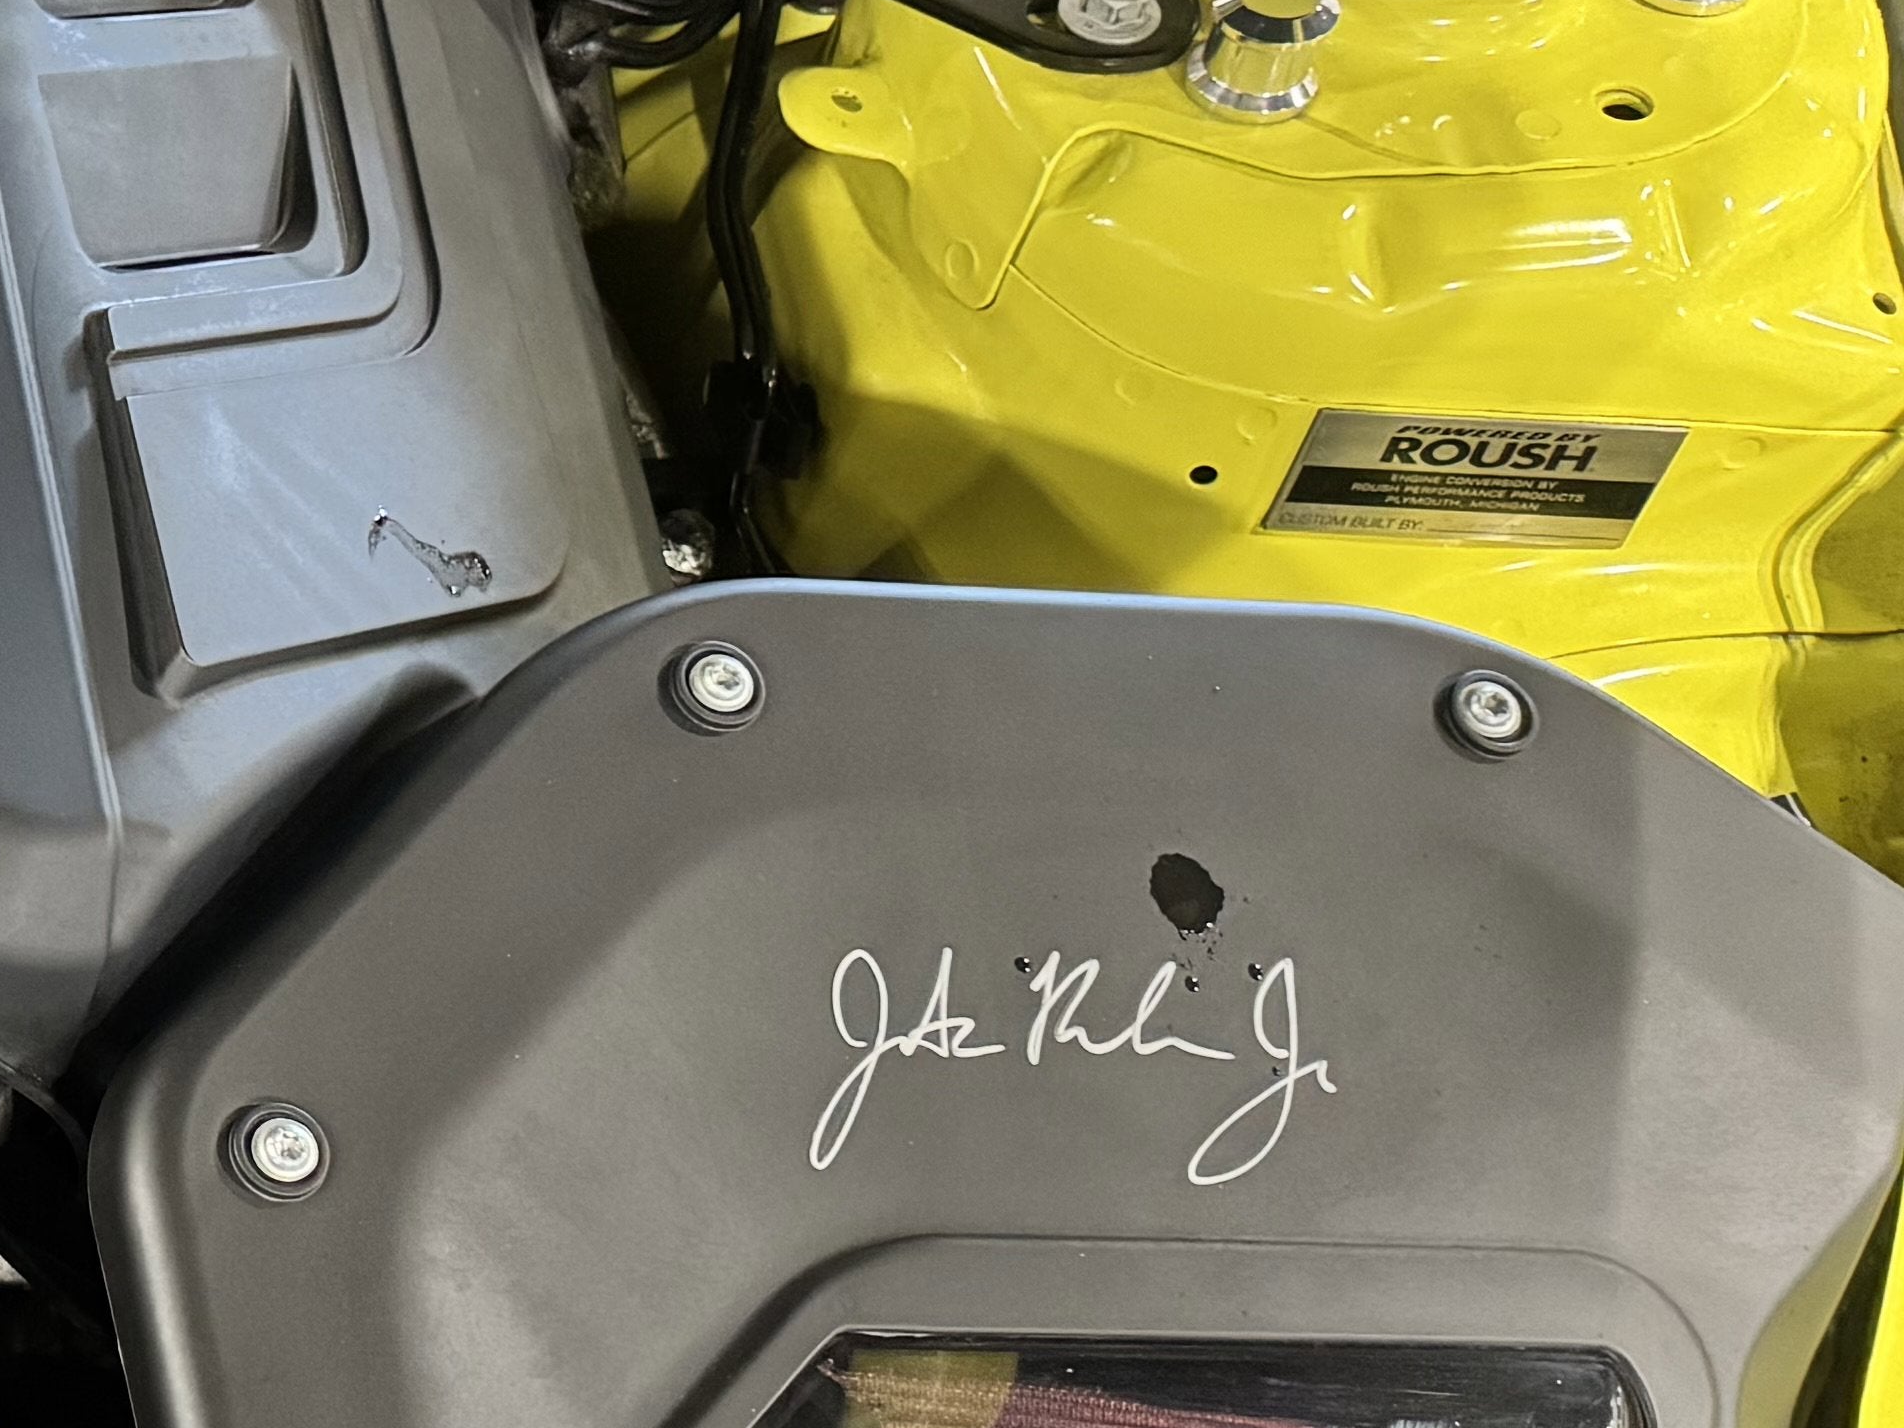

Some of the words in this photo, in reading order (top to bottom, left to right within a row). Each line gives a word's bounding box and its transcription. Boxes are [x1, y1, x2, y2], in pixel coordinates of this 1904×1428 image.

[1396, 424, 1552, 441] POWERED
[1554, 432, 1600, 444] BY
[1379, 436, 1598, 472] ROUSH
[1390, 474, 1440, 485] ENGINE
[1445, 476, 1535, 489] CONVERSION
[1538, 480, 1558, 490] BY
[1351, 482, 1401, 494] ROUSH
[1404, 484, 1507, 499] PERFORMANCE
[1510, 491, 1586, 503] PRODUCTS
[1385, 495, 1464, 508] PLYMOUTH,
[1470, 500, 1540, 512] MICHIGAN
[1278, 512, 1348, 526] CUSTOM
[1349, 514, 1394, 529] BUILT
